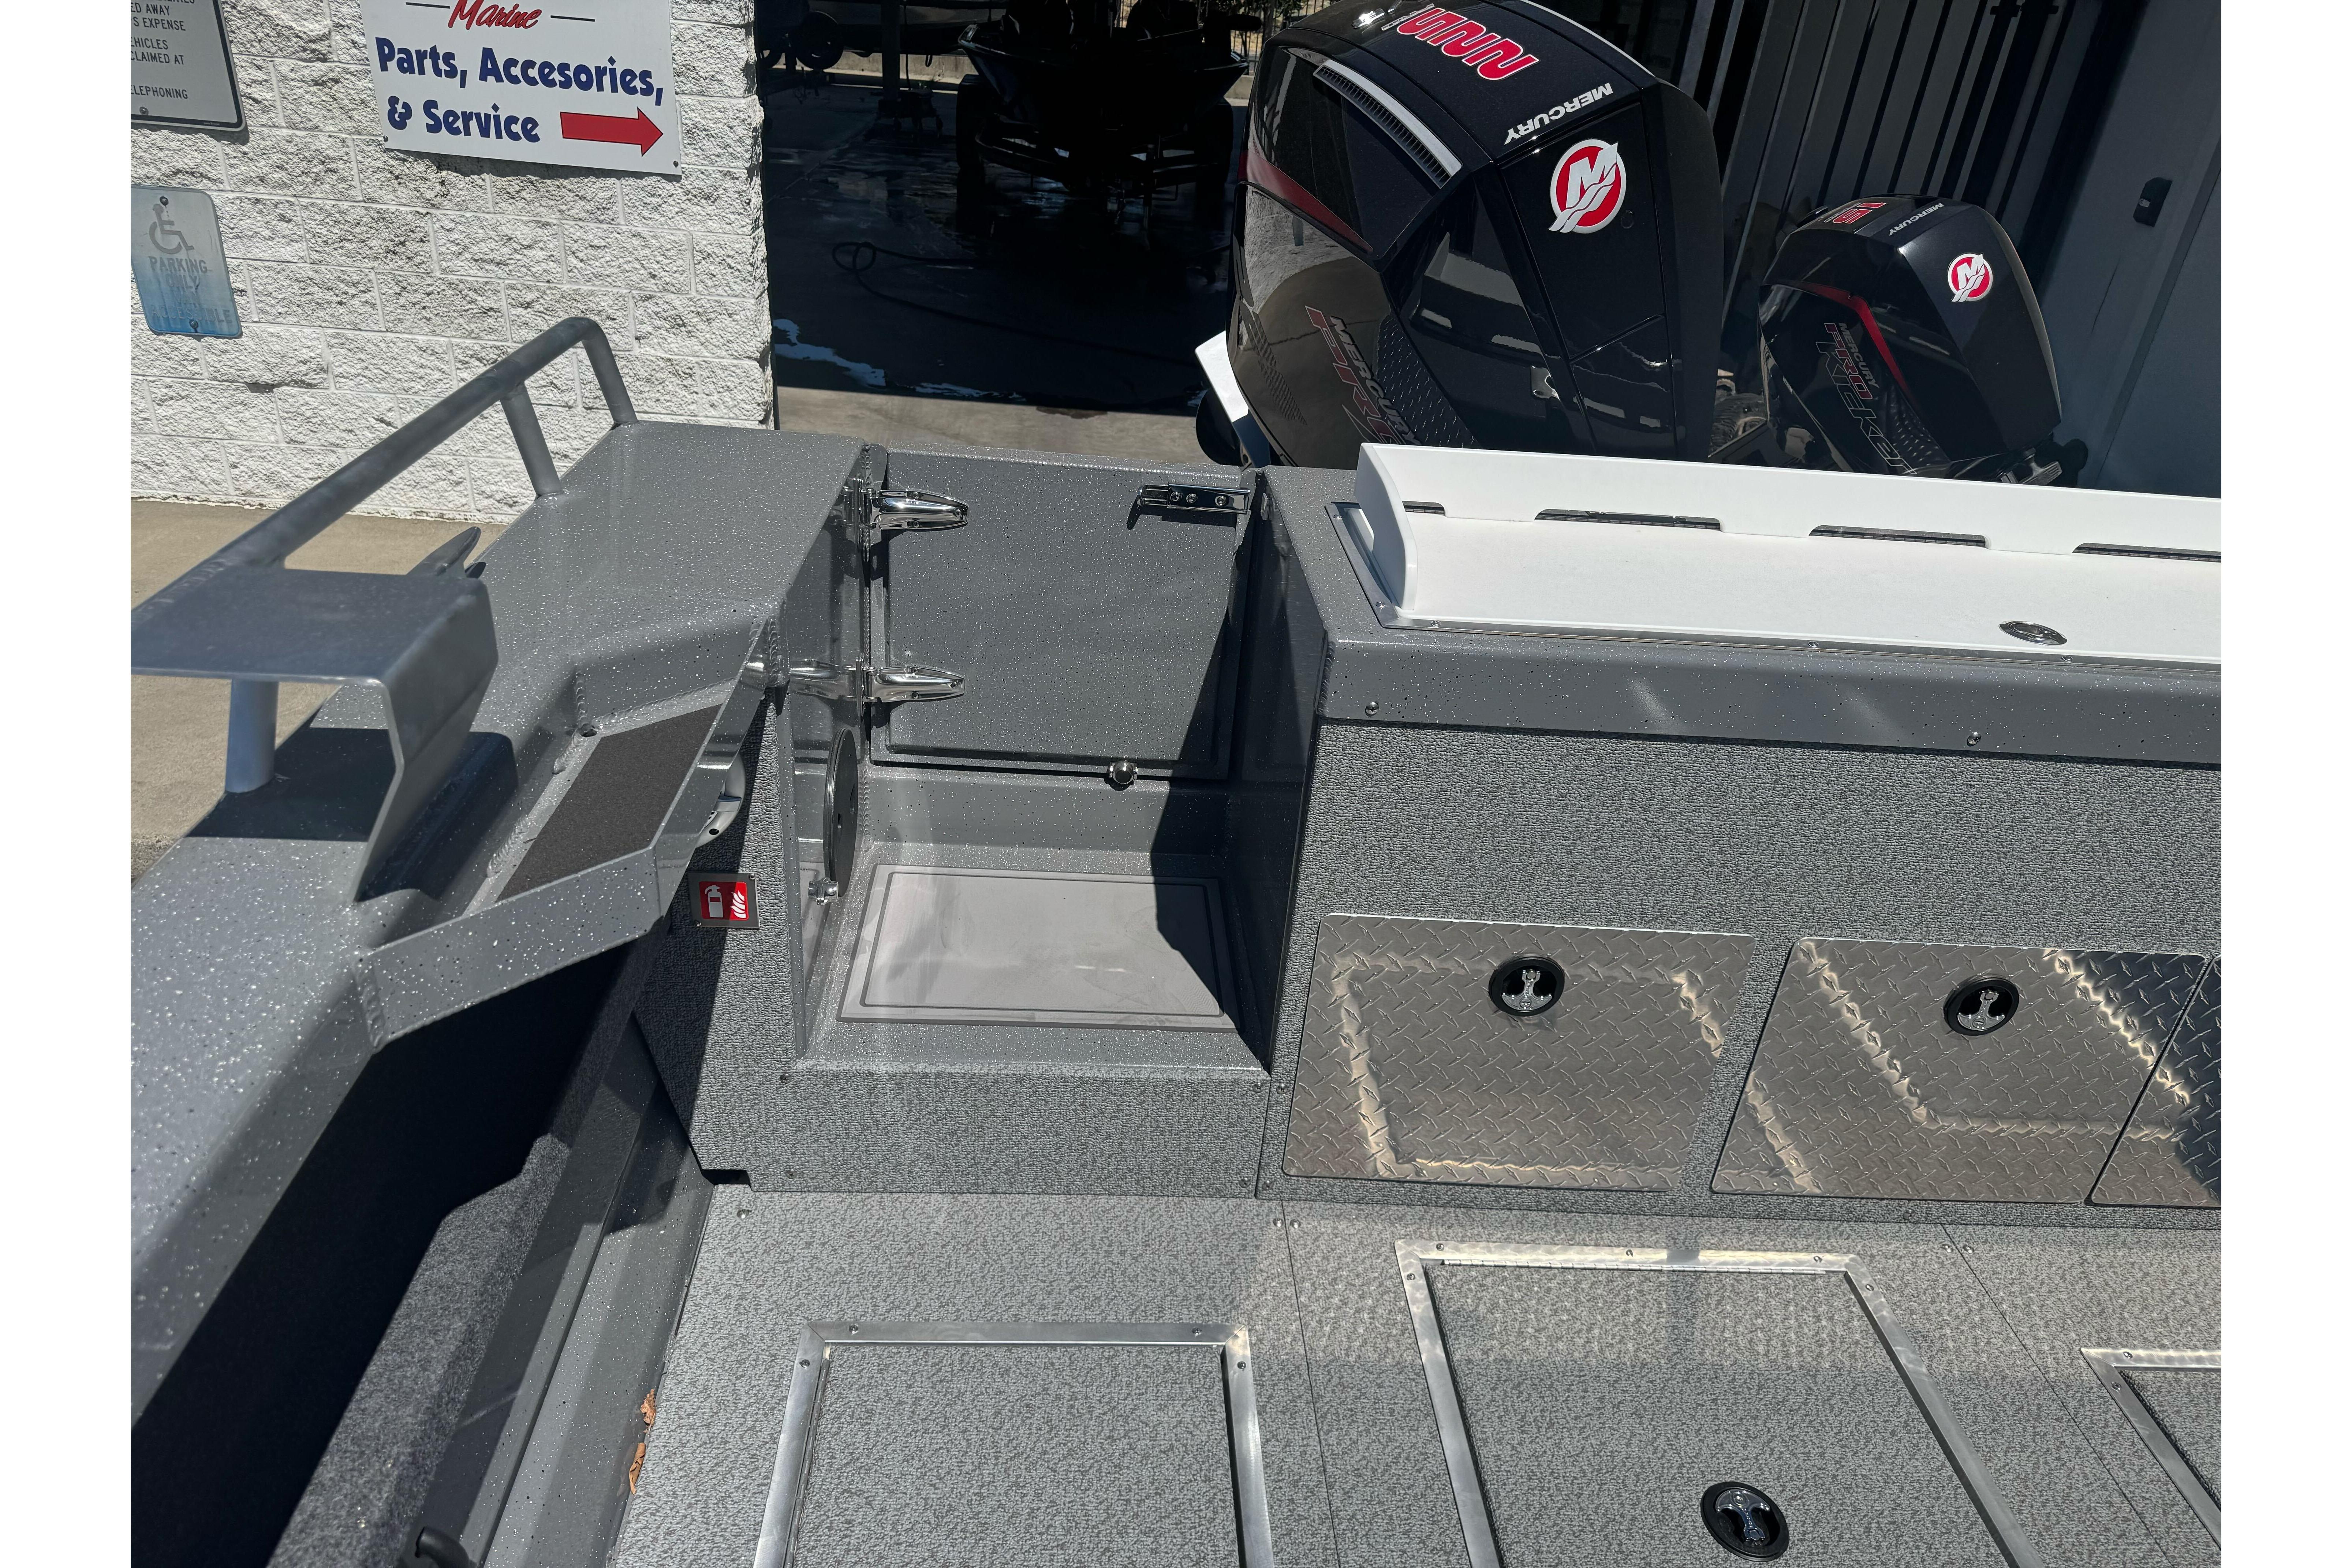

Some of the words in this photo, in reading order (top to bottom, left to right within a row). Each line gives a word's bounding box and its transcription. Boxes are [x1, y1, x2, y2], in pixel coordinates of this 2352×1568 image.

[142, 17, 186, 31] EXPENSE
[146, 4, 169, 16] AWAY
[448, 0, 542, 30] Marine
[174, 55, 184, 65] AT
[375, 37, 467, 89] Parts,
[478, 47, 664, 106] Accesories,
[387, 95, 413, 130] &
[422, 99, 541, 143] Service
[1504, 83, 1613, 145] MERCURY
[1832, 202, 1886, 224] 15
[1889, 203, 1944, 236] MERCURY
[149, 256, 208, 274] PARKING
[166, 273, 200, 292] ONLY
[1824, 323, 1873, 400] PRO
[1838, 322, 1879, 388] MERCURY
[1329, 316, 1422, 445] MERCURY
